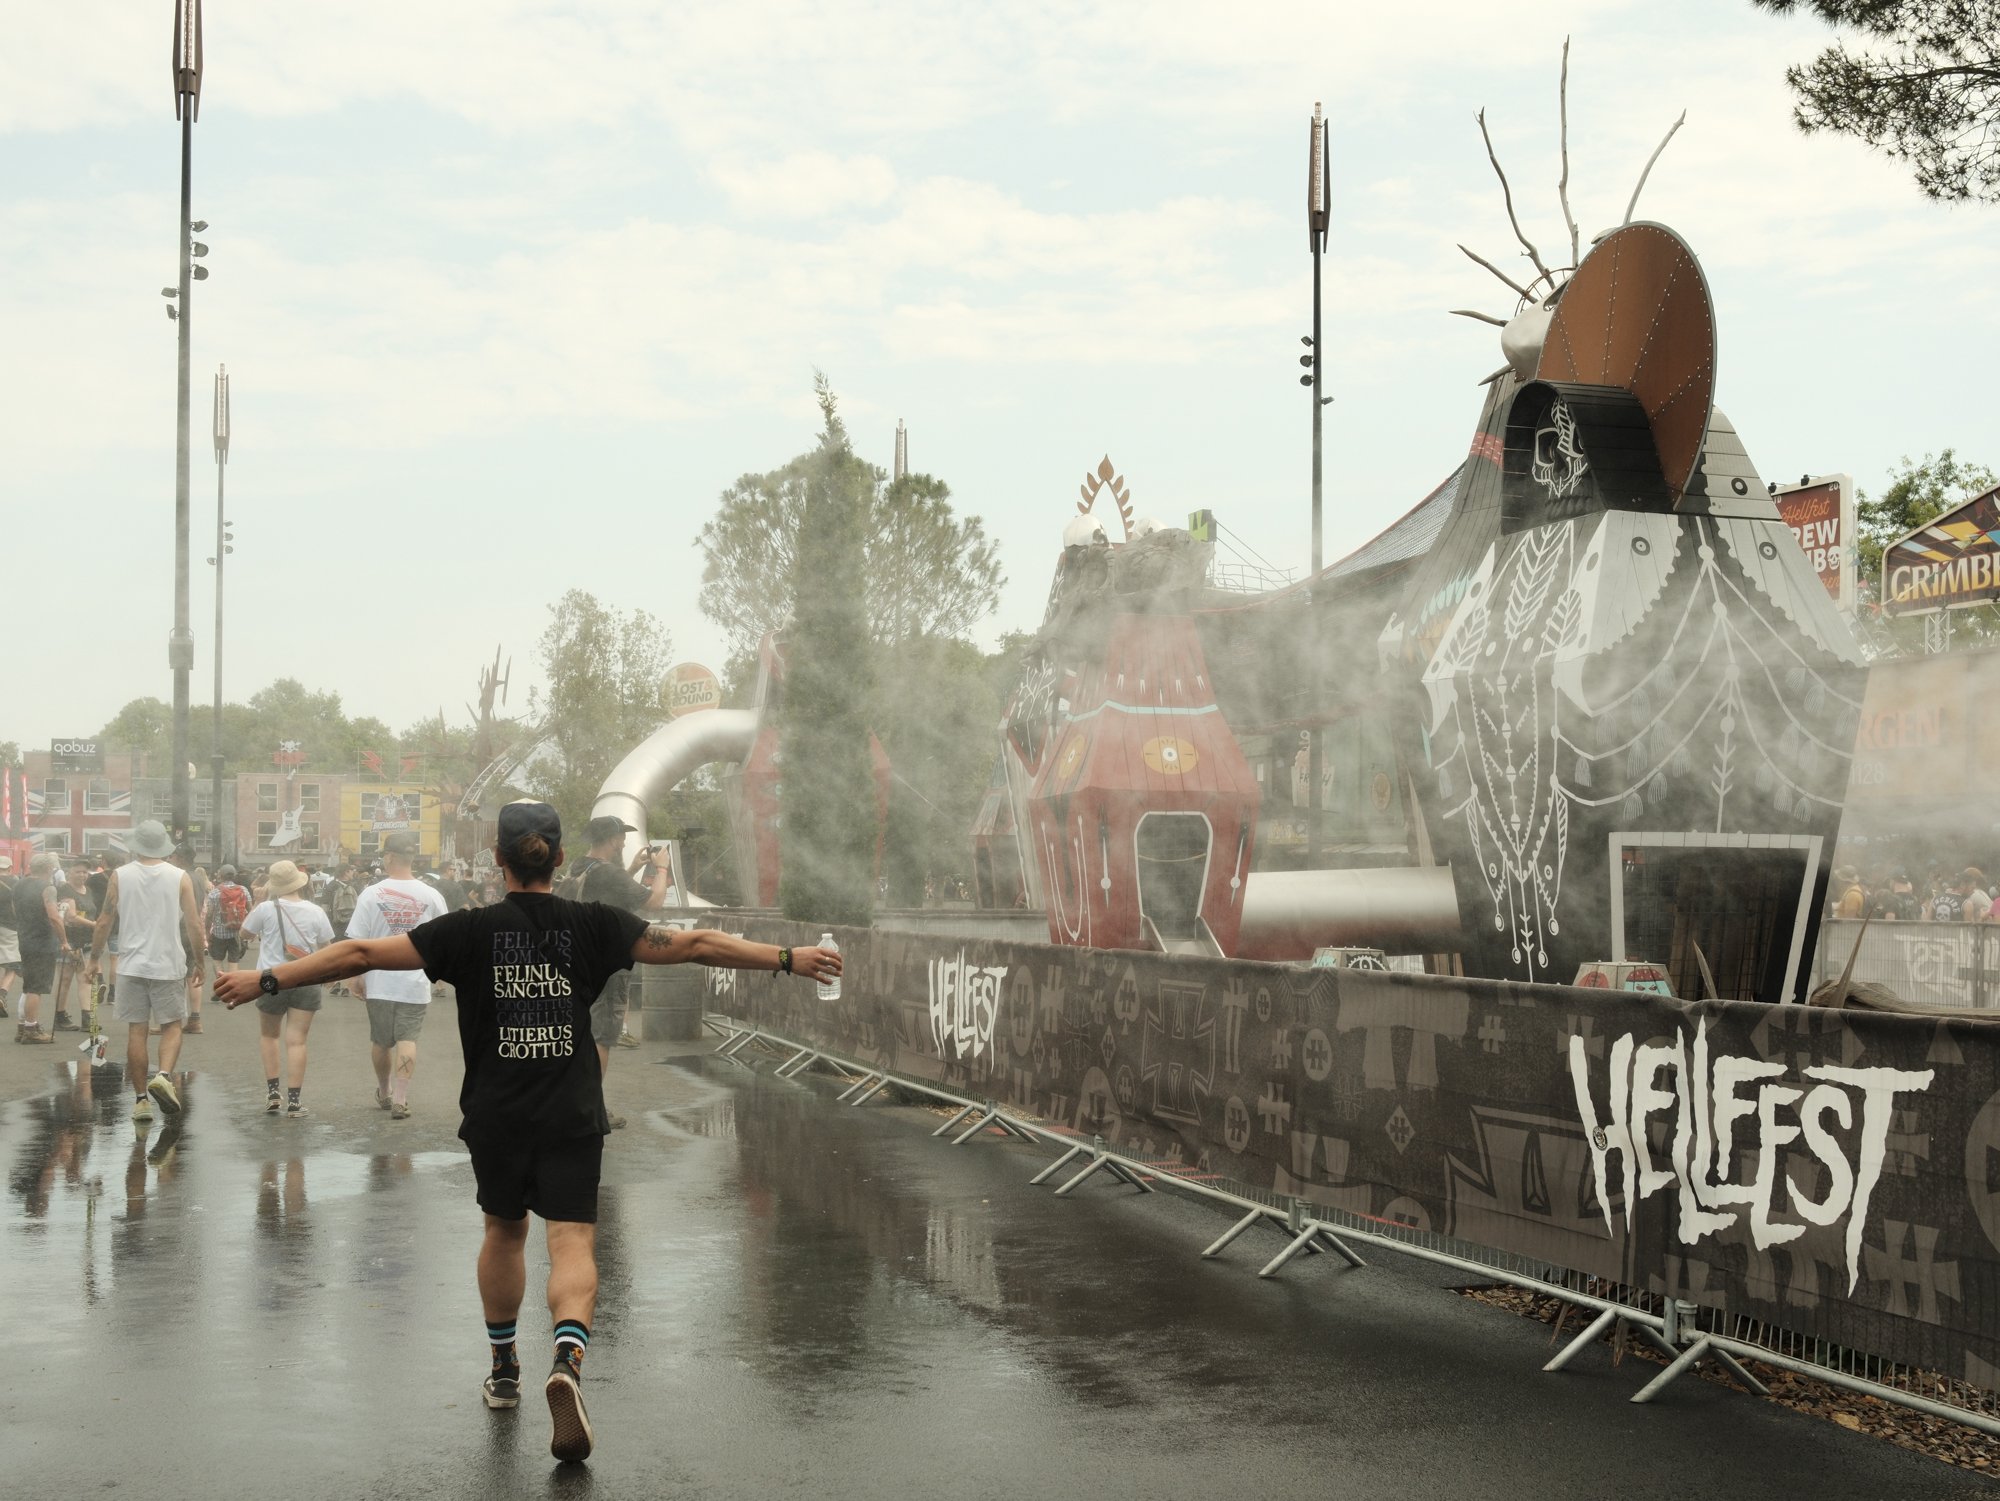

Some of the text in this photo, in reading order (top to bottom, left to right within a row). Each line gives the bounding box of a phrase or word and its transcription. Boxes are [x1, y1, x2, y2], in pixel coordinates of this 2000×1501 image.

[1782, 497, 1830, 523] Hellfest
[673, 681, 704, 696] LOST
[54, 740, 96, 757] qobuz
[493, 979, 572, 998] SANCTUS
[928, 946, 1009, 1075] HELLFEST
[498, 1040, 574, 1059] CROTTUS
[1569, 1014, 1935, 1298] HELLFEST
